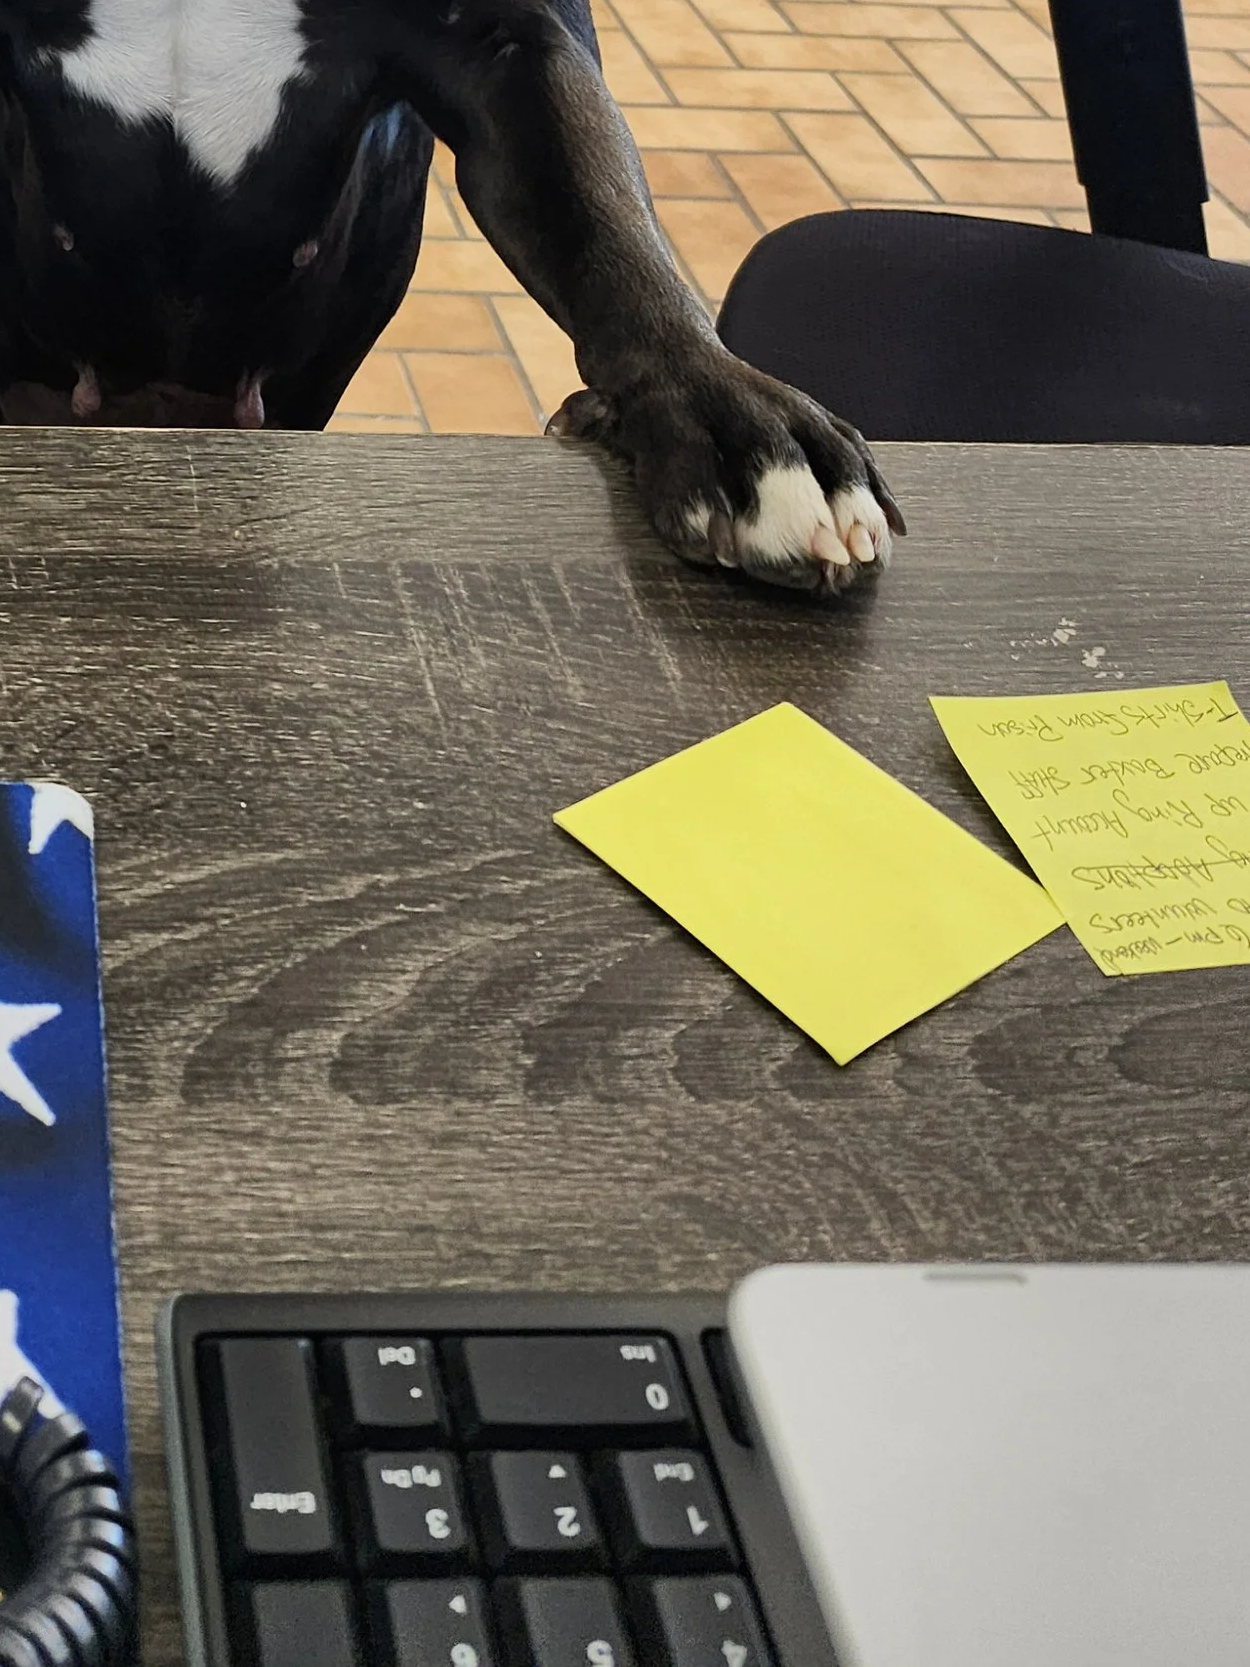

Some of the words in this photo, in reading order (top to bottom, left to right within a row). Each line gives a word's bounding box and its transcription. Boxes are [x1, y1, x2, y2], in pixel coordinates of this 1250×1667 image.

[1057, 709, 1130, 736] from
[1079, 757, 1176, 786] Baxter
[1112, 788, 1203, 830] Ring
[1203, 793, 1249, 818] up
[1031, 810, 1129, 852] Account
[377, 1345, 416, 1366] Del
[619, 1344, 657, 1363] Ins
[645, 1382, 669, 1411] 0
[250, 1490, 317, 1514] Enter
[424, 1508, 451, 1539] 3
[553, 1506, 582, 1537] 2
[686, 1505, 710, 1536] 1
[586, 1639, 615, 1667] 5
[721, 1639, 748, 1667] 4
